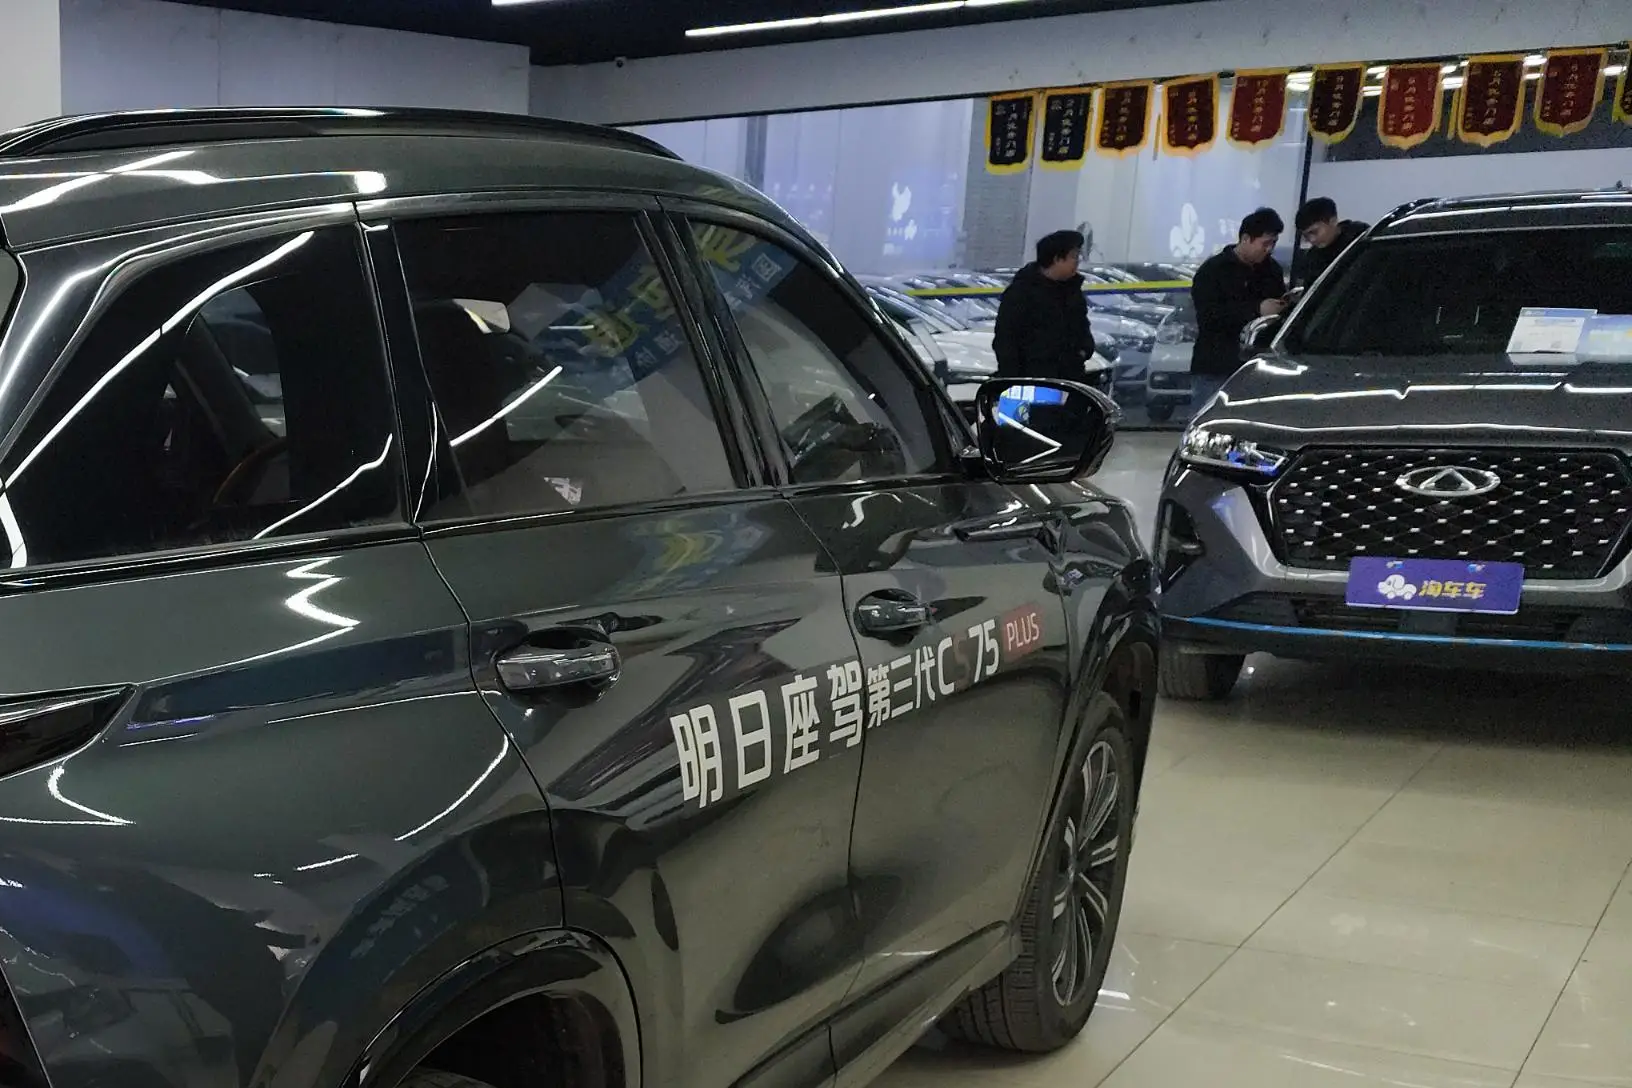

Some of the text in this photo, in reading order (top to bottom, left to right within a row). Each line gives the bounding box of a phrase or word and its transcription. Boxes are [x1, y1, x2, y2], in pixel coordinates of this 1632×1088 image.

[1418, 580, 1487, 599] 淘车车
[1005, 612, 1040, 652] PLUS
